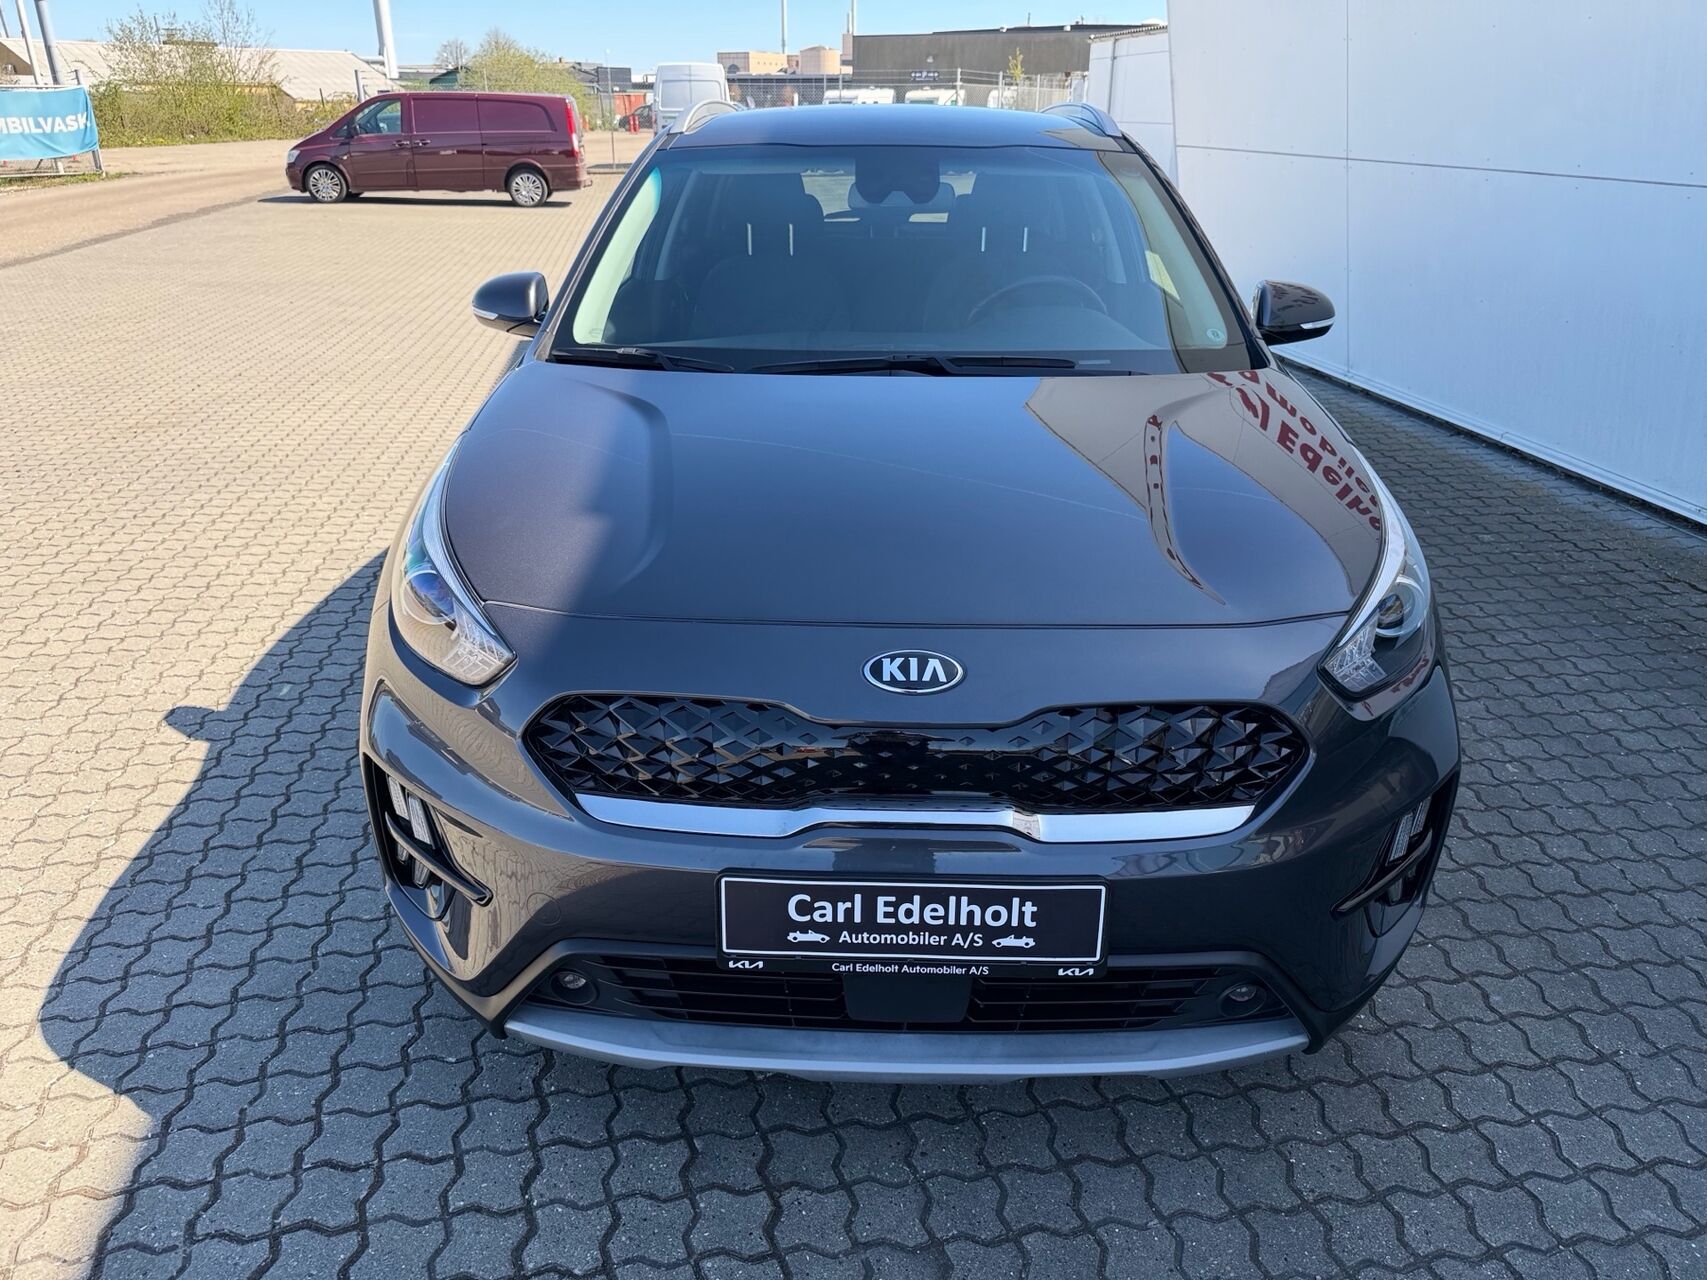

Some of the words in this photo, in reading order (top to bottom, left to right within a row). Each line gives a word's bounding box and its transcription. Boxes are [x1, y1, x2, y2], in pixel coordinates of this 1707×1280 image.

[881, 657, 948, 682] KIA
[787, 893, 861, 923] Carl
[876, 895, 1038, 928] Edelholt
[838, 931, 948, 946] Automobiler
[951, 933, 984, 949] A/S
[831, 963, 853, 973] Carl
[855, 963, 899, 973] Edelholt
[901, 964, 967, 975] Automobiler
[969, 966, 989, 975] A/S
